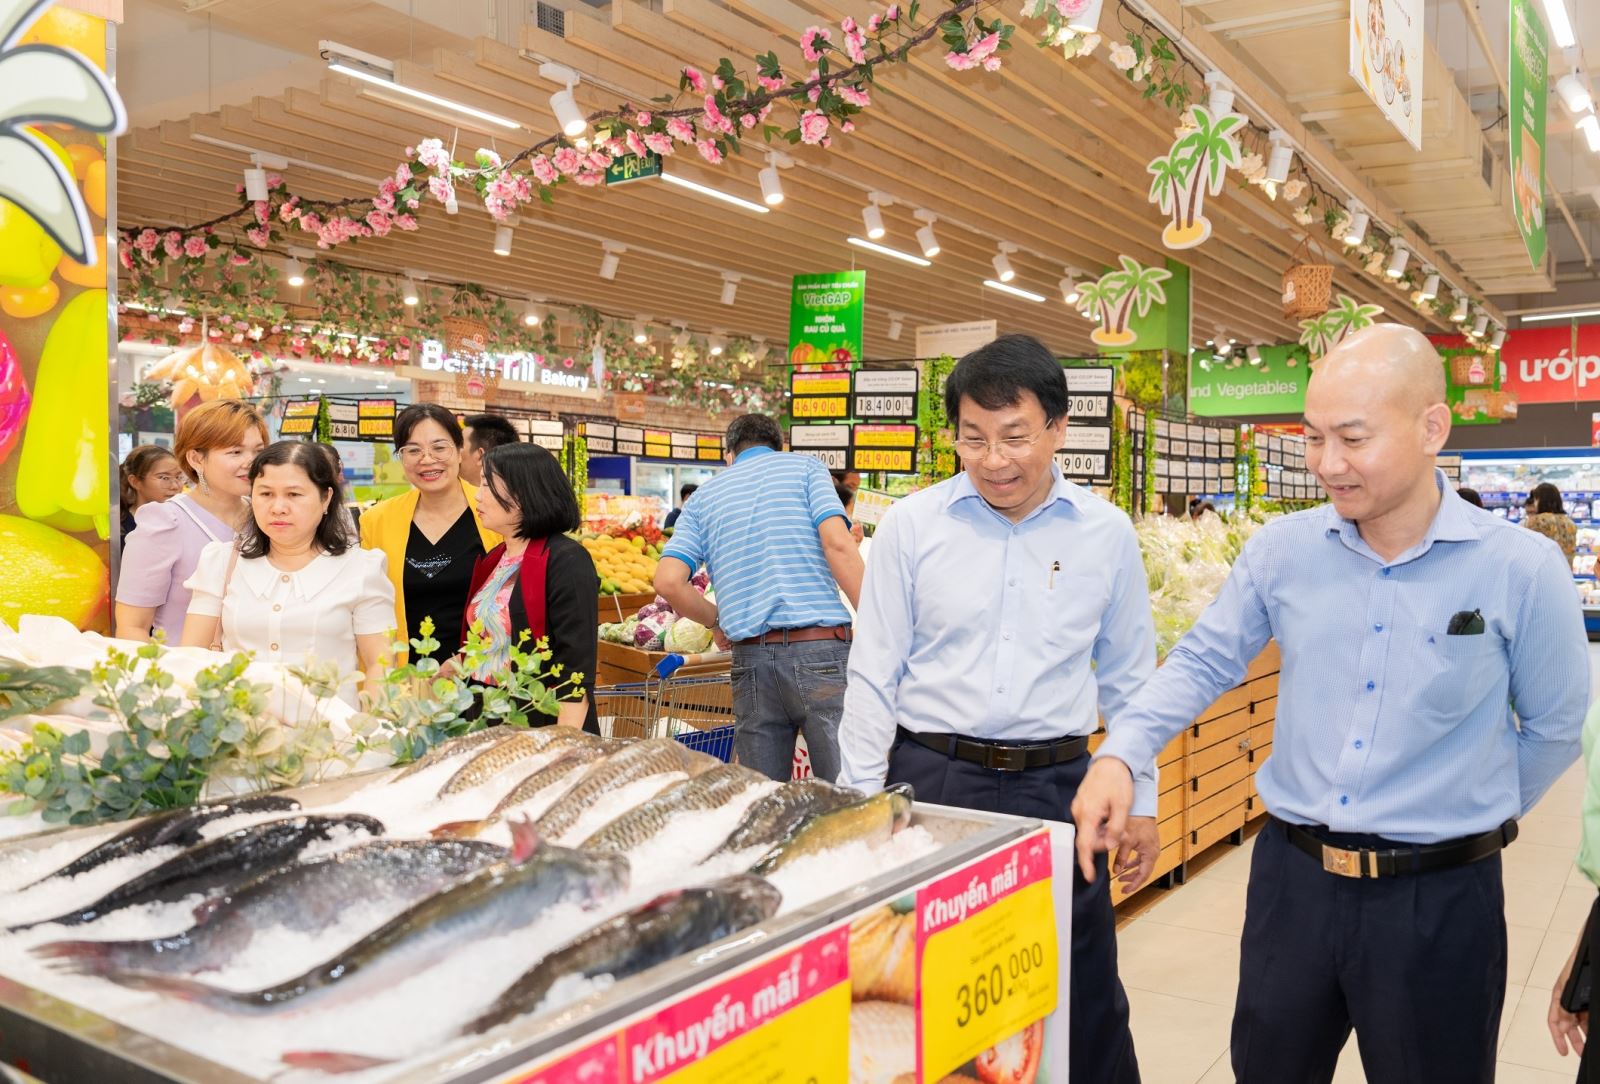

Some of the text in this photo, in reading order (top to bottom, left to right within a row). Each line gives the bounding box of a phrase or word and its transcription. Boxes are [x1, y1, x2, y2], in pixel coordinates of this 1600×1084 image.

[803, 291, 851, 306] VietGAP
[541, 368, 589, 393] Bakery
[1217, 380, 1298, 400] Vegetables
[922, 875, 989, 932] Khuyến
[631, 994, 746, 1084] Khuyến
